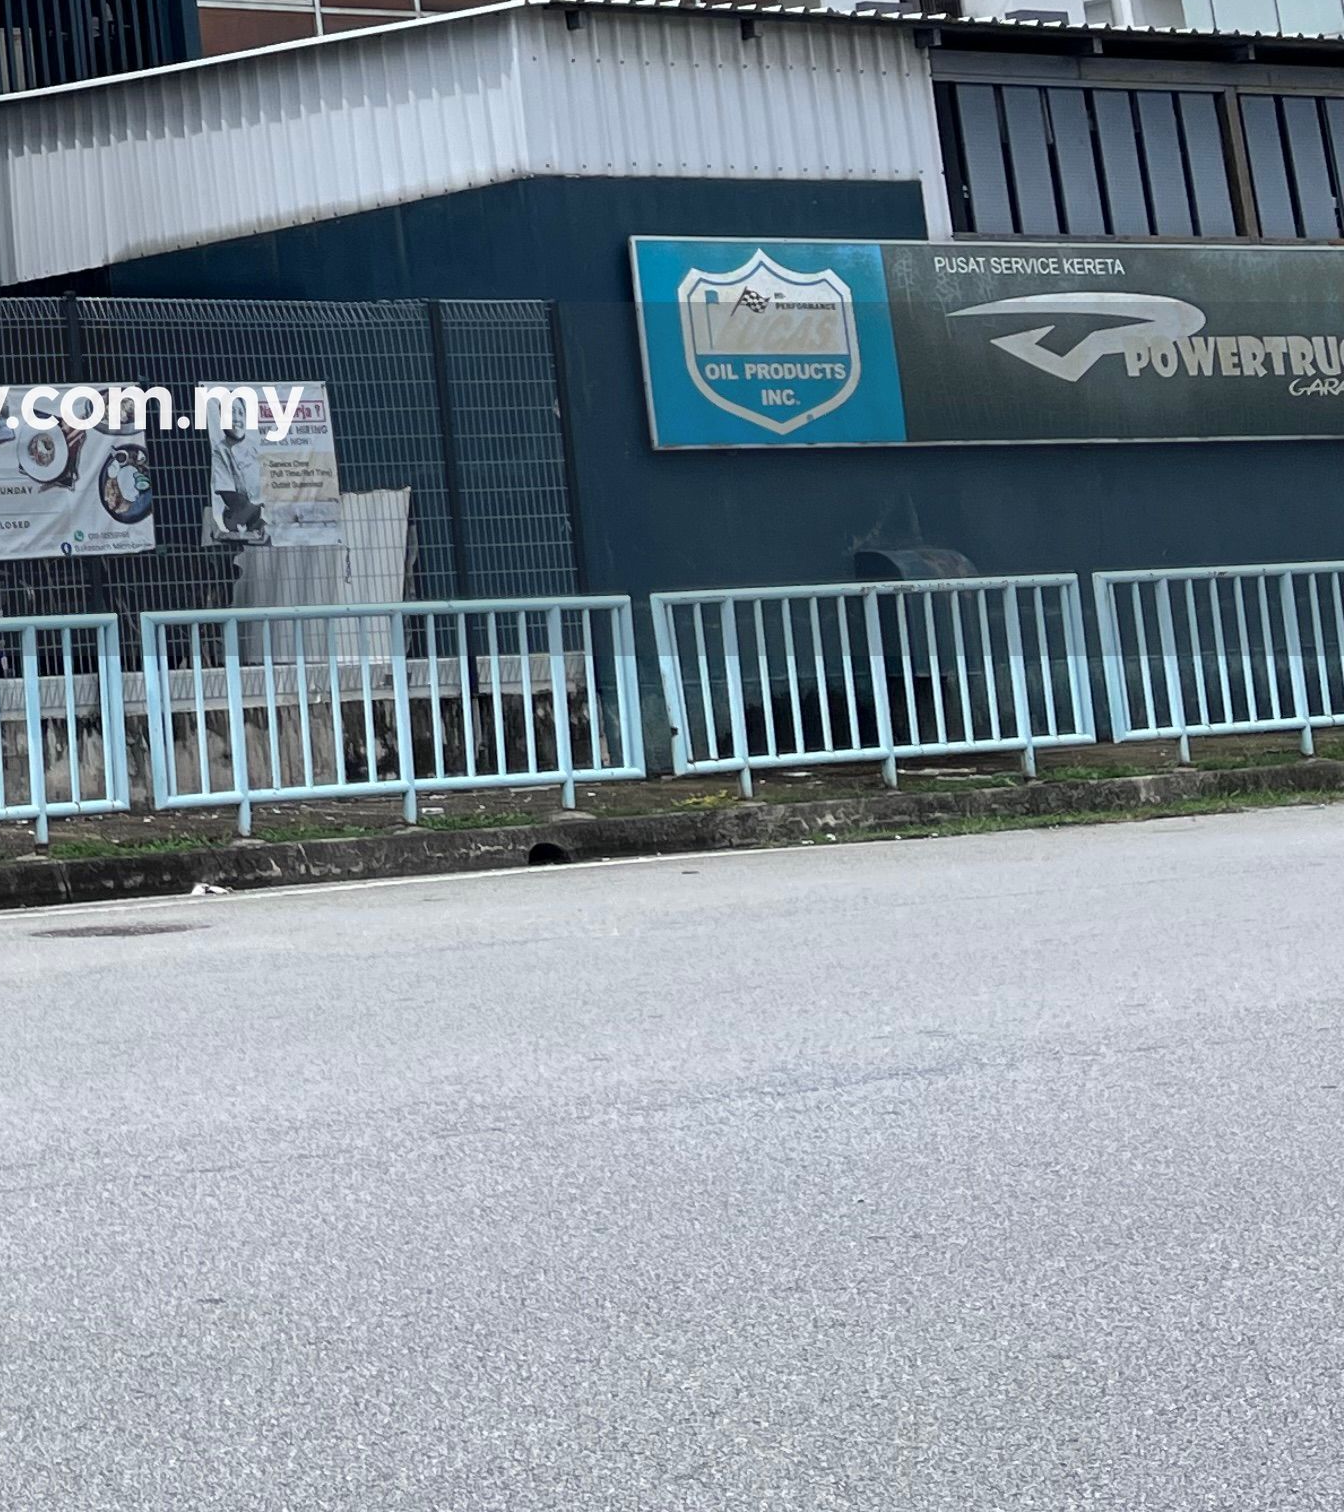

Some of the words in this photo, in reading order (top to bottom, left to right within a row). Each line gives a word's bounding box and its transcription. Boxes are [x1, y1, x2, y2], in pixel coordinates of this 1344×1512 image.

[934, 256, 985, 274] PUSAT
[990, 257, 1061, 275] SERVICE
[1063, 258, 1126, 275] KERETA
[775, 302, 837, 311] PERFORMANCE
[704, 363, 739, 380] OIL
[745, 363, 847, 380] PRODUCTS
[761, 389, 801, 406] INC.
